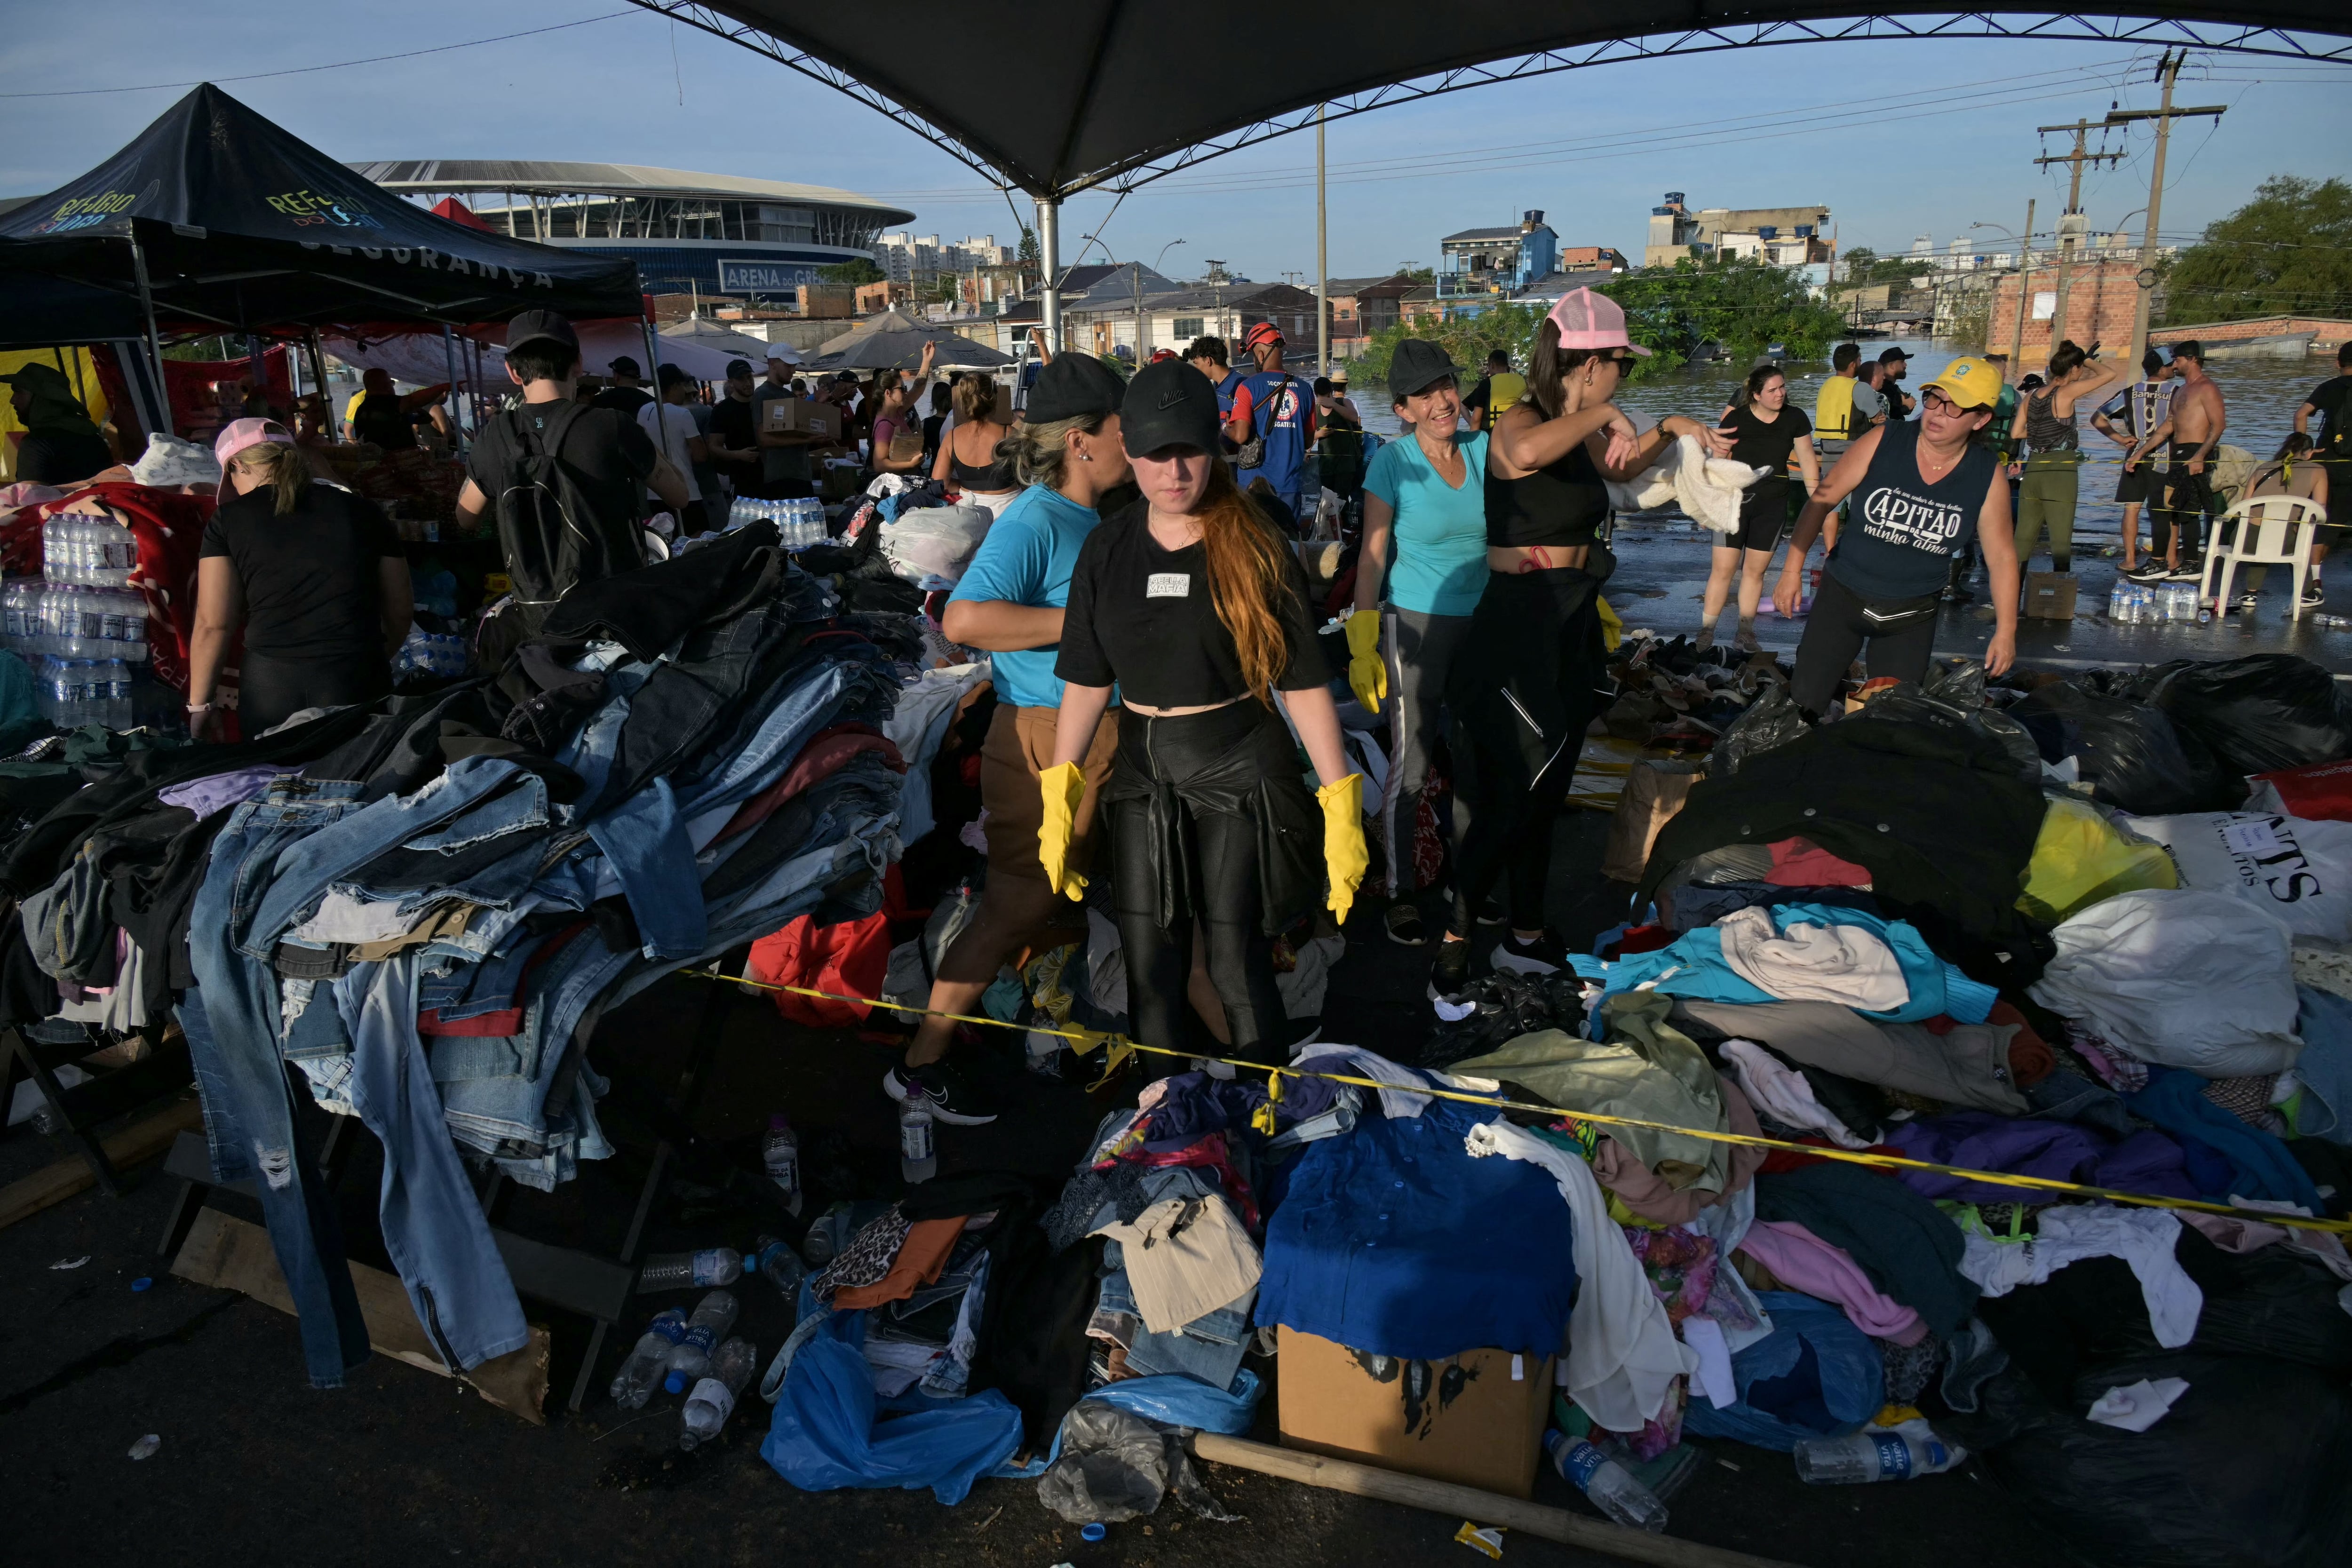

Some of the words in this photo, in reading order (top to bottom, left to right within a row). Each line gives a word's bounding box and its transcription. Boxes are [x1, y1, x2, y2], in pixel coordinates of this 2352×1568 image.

[293, 216, 324, 226] DO
[727, 268, 780, 287] ARENA
[783, 278, 793, 286] DO
[795, 267, 830, 285] GRÊ
[1162, 390, 1185, 402] NIKE
[2131, 390, 2173, 401] Banrisul
[2143, 404, 2156, 434] 9
[1911, 495, 1927, 504] senhor
[1947, 504, 1963, 512] destino
[1864, 524, 1910, 545] minha
[1912, 532, 1949, 555] alma
[1148, 583, 1186, 594] MAFIA
